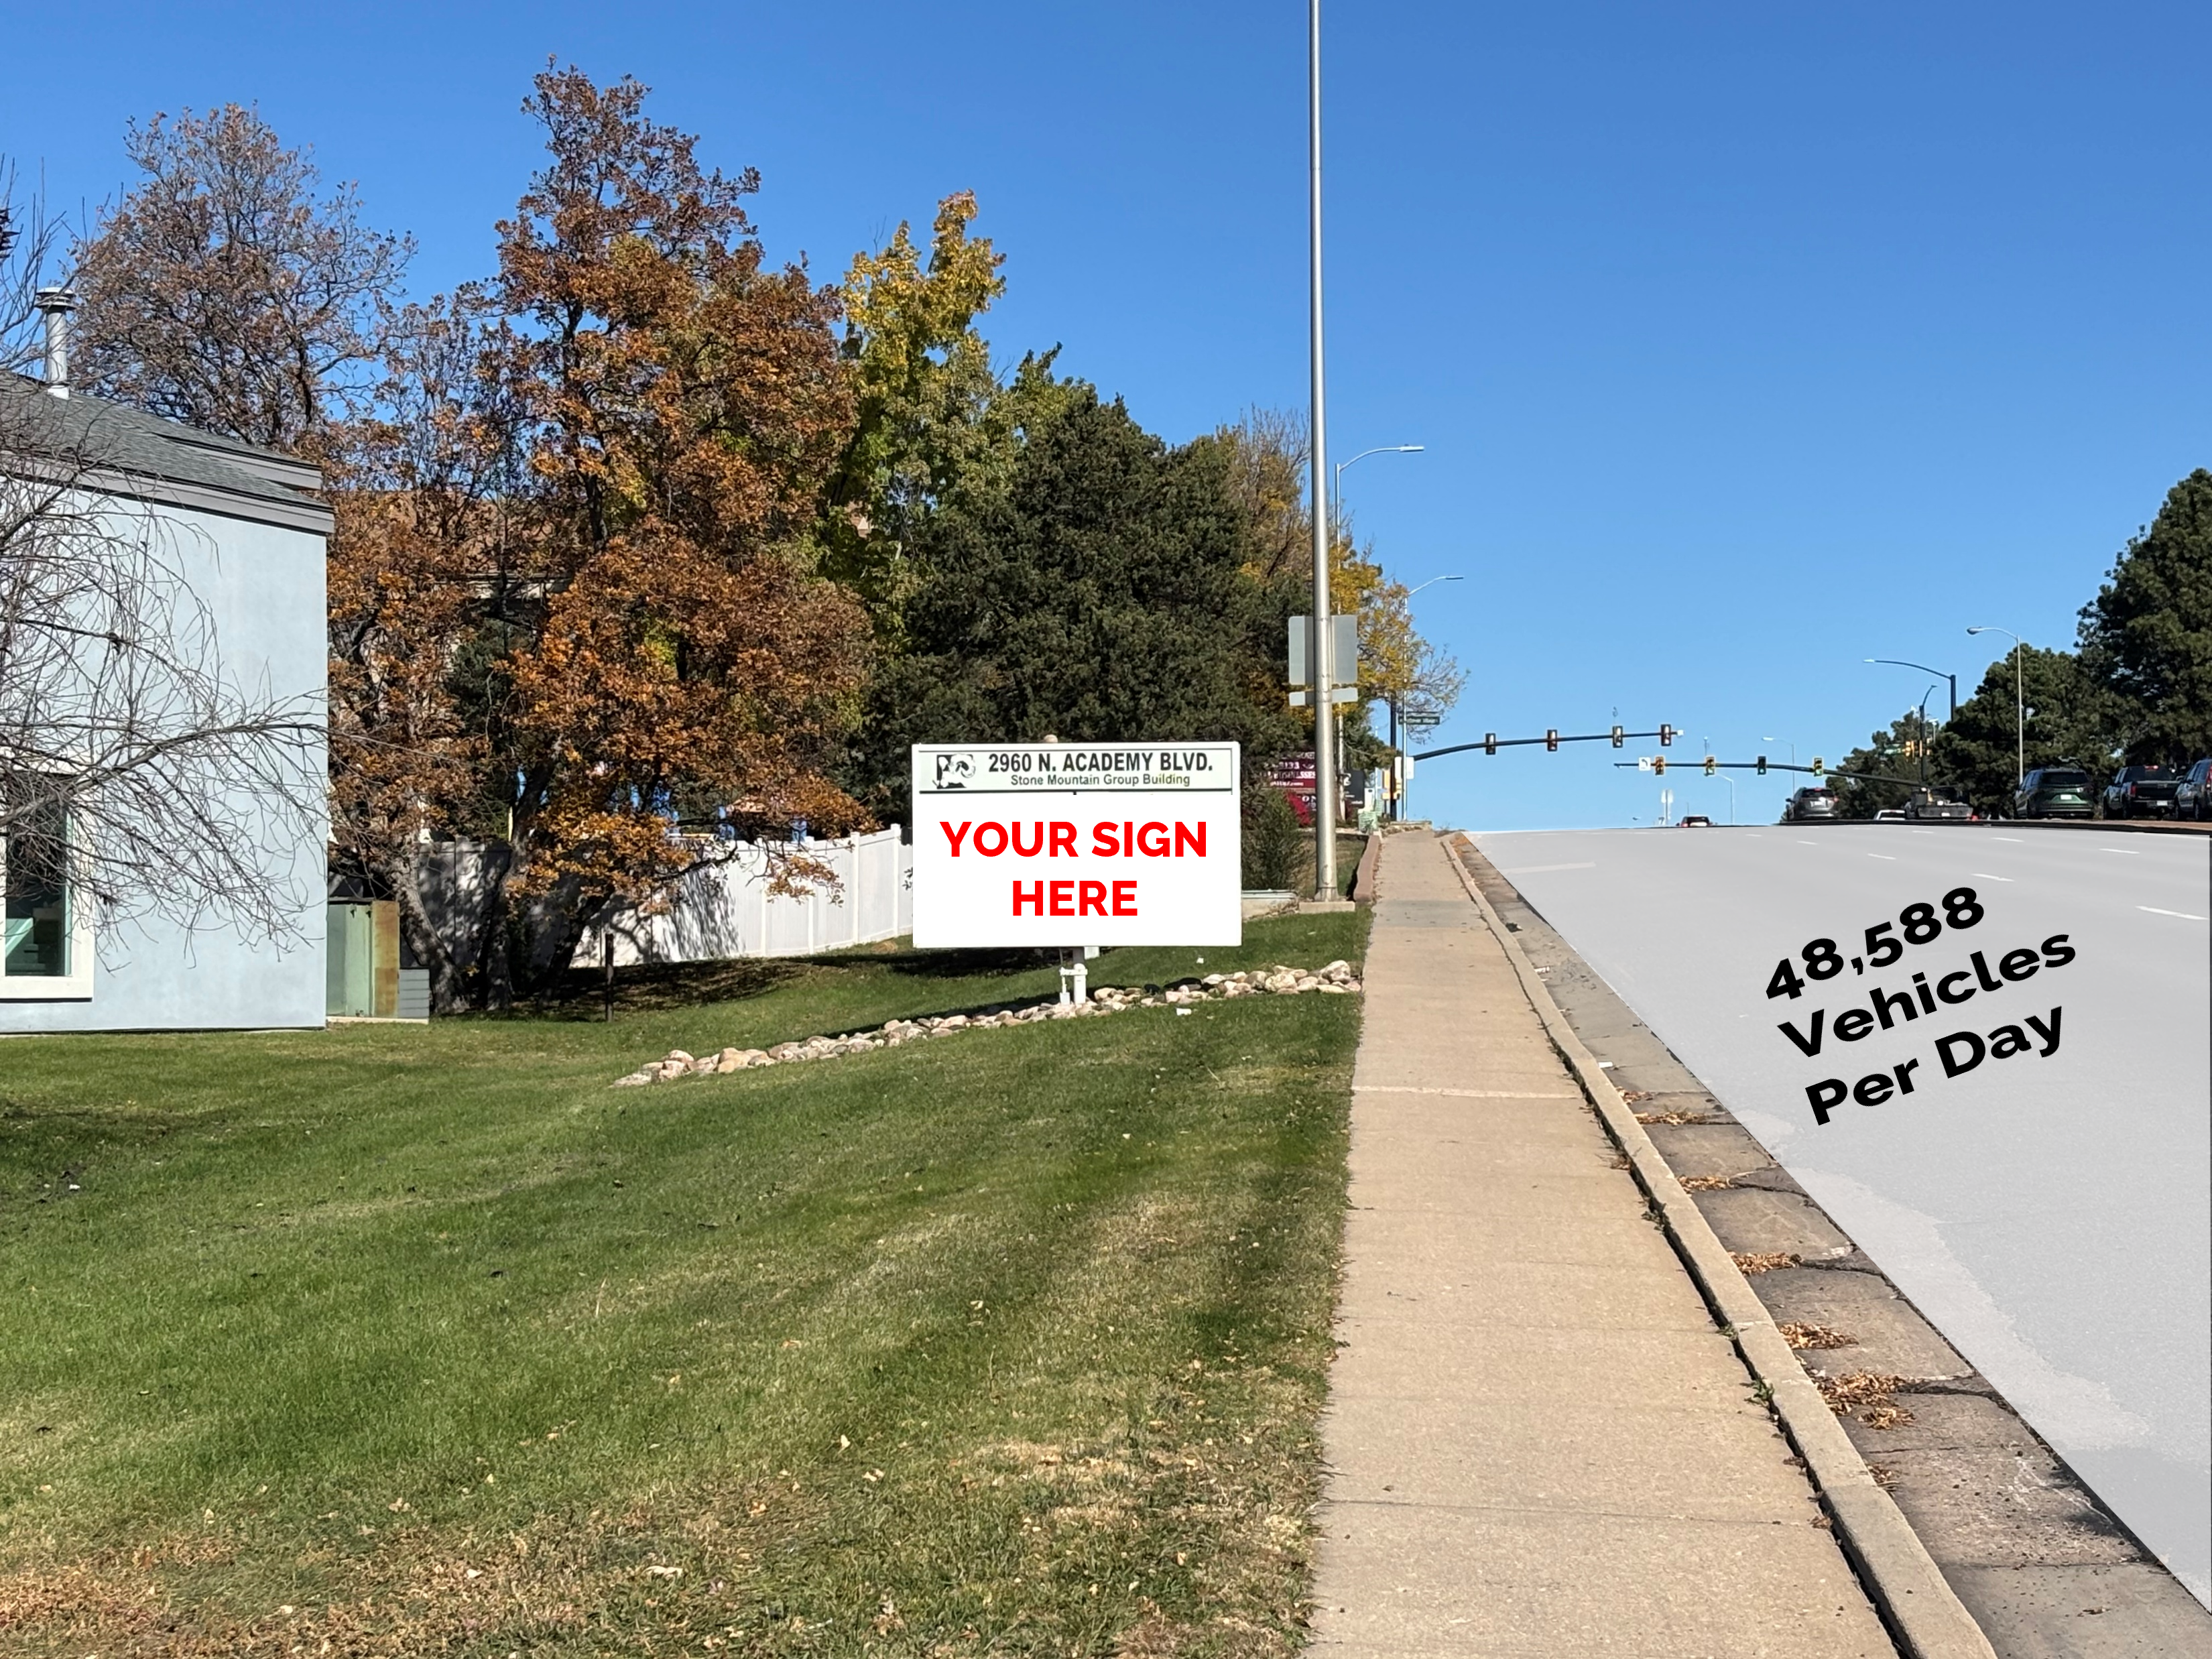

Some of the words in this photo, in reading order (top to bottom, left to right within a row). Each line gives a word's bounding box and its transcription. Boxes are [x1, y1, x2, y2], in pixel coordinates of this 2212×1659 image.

[989, 753, 1032, 772] 2960
[1038, 753, 1056, 772] N.
[1062, 752, 1154, 772] ACADEMY
[1160, 752, 1213, 772] BLVD.
[1011, 774, 1044, 786] Stone
[1048, 774, 1099, 786] Mountain
[1103, 774, 1139, 787] Group
[1143, 774, 1190, 787] Building
